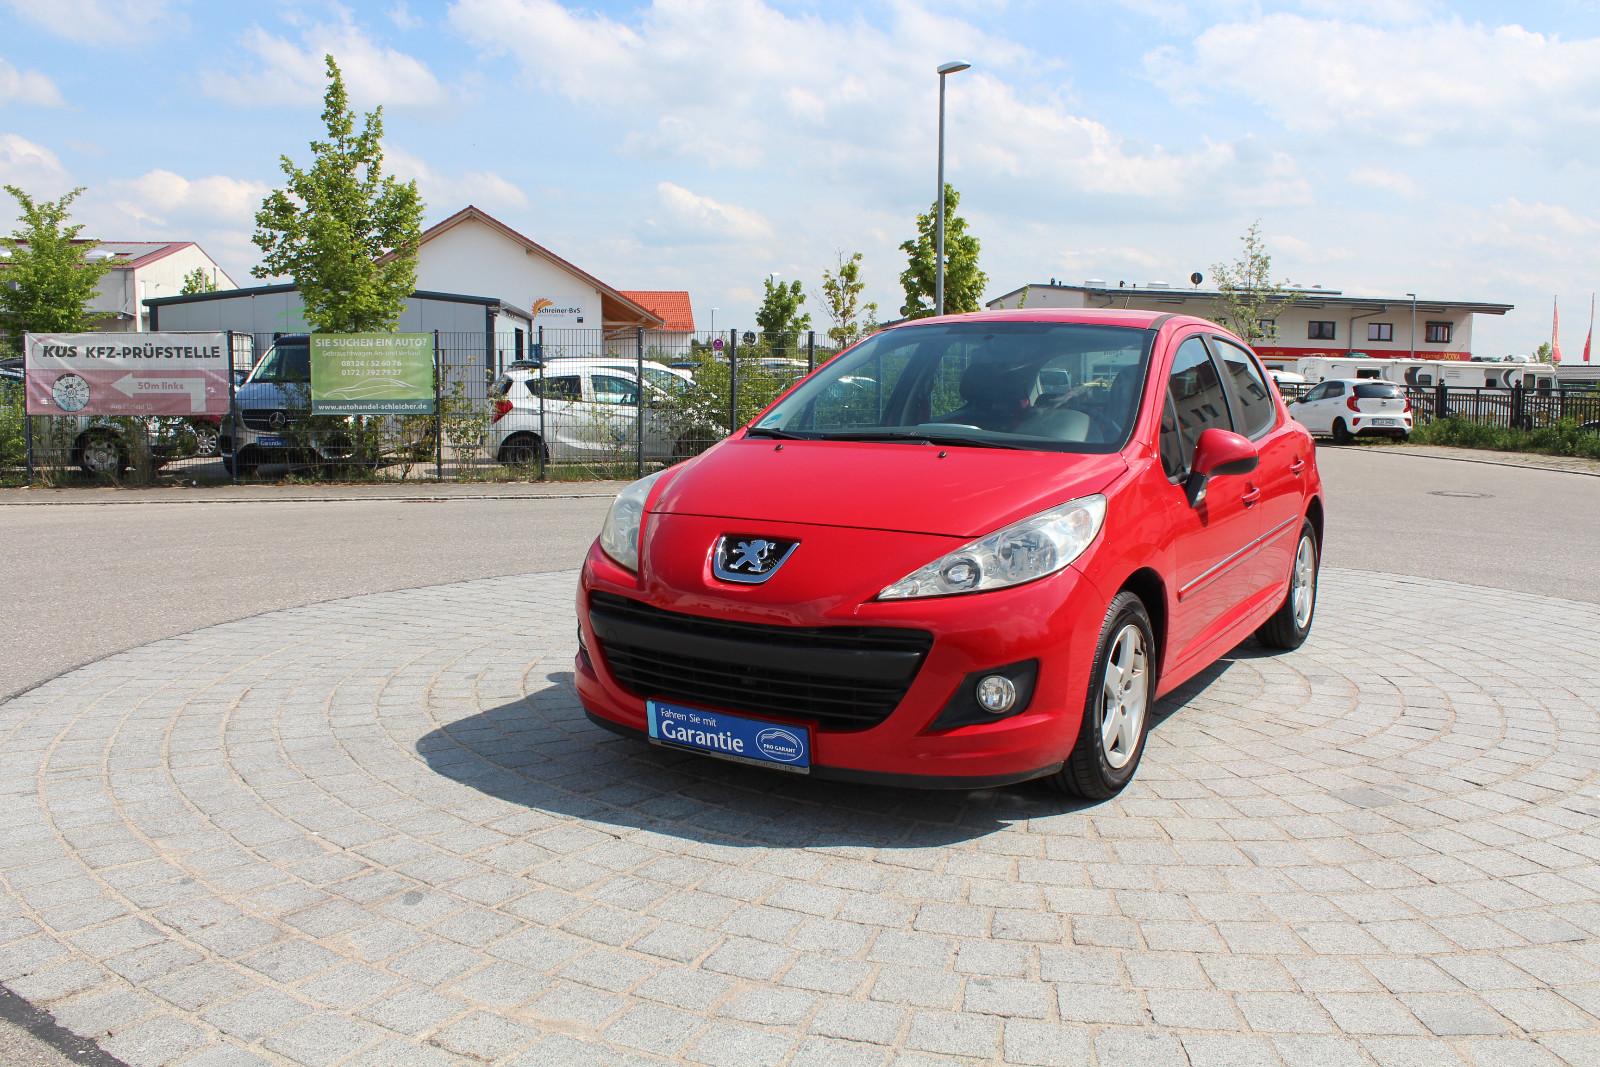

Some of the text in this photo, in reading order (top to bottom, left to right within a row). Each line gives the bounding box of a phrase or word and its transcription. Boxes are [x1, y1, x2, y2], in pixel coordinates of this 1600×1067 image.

[315, 338, 427, 347] SIE SUCHEN EIN AUTO?
[42, 343, 221, 359] KÜS KFZ-PRÜFSTELLE
[137, 381, 184, 390] 50m links
[660, 707, 717, 727] Fahren Sie mit
[661, 719, 744, 752] Garantie
[763, 743, 774, 751] PRO
[774, 745, 796, 754] GARANT
